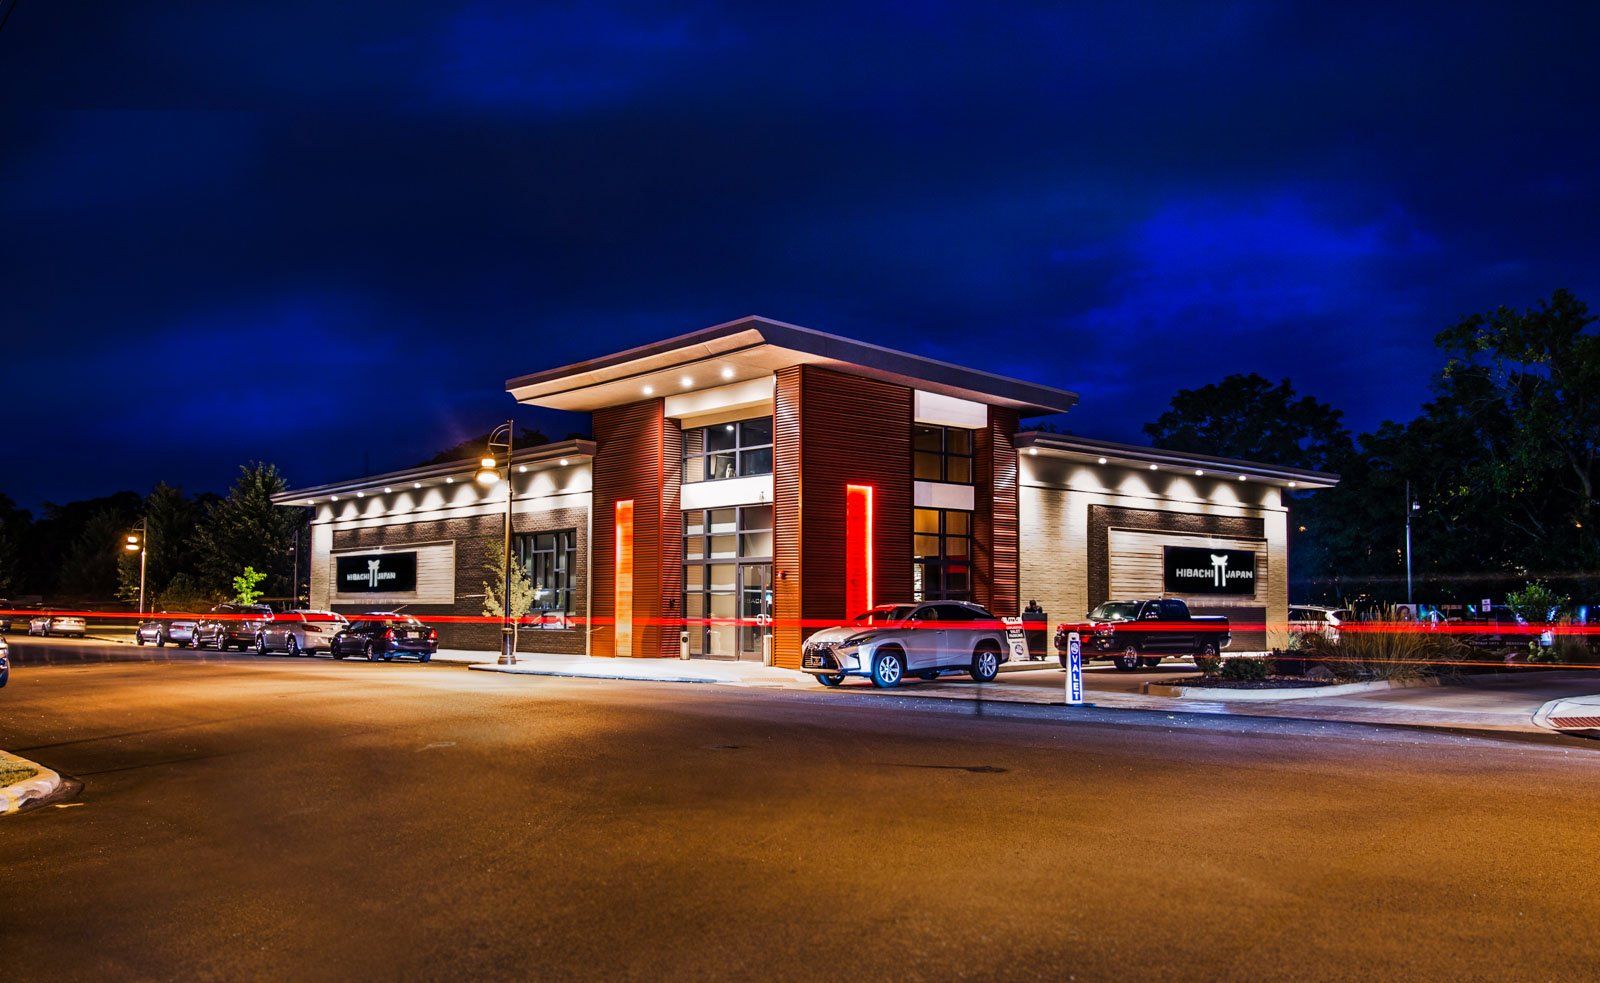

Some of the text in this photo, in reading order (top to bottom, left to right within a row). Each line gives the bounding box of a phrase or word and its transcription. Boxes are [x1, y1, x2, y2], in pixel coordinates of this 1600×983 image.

[346, 572, 396, 581] HIBACHI JAPAN
[1176, 568, 1253, 579] HIBACHI JAPAN
[1072, 654, 1080, 700] VALET
